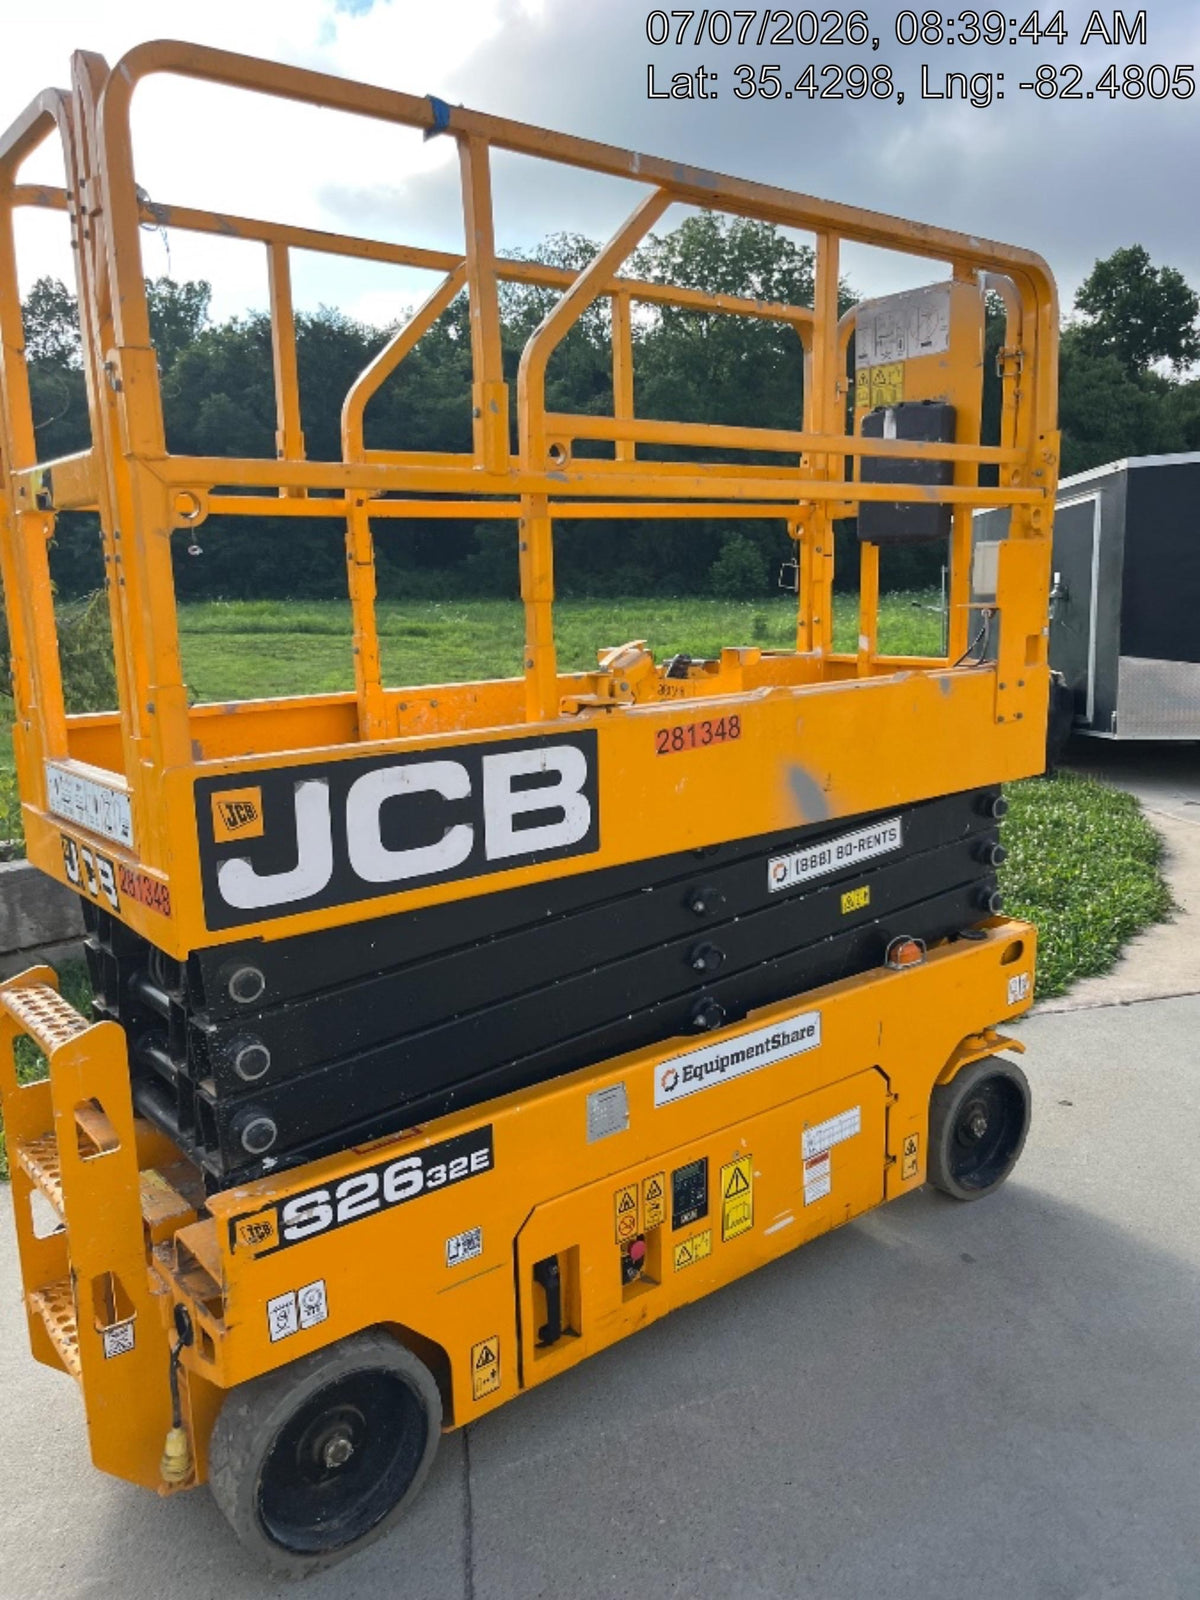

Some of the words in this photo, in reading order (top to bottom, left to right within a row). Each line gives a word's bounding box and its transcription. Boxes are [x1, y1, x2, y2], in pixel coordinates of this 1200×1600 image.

[656, 714, 741, 755] 281348
[217, 744, 592, 910] JCB
[223, 803, 256, 828] JCB
[118, 863, 172, 917] 281348
[681, 1024, 816, 1084] EquipmentShare
